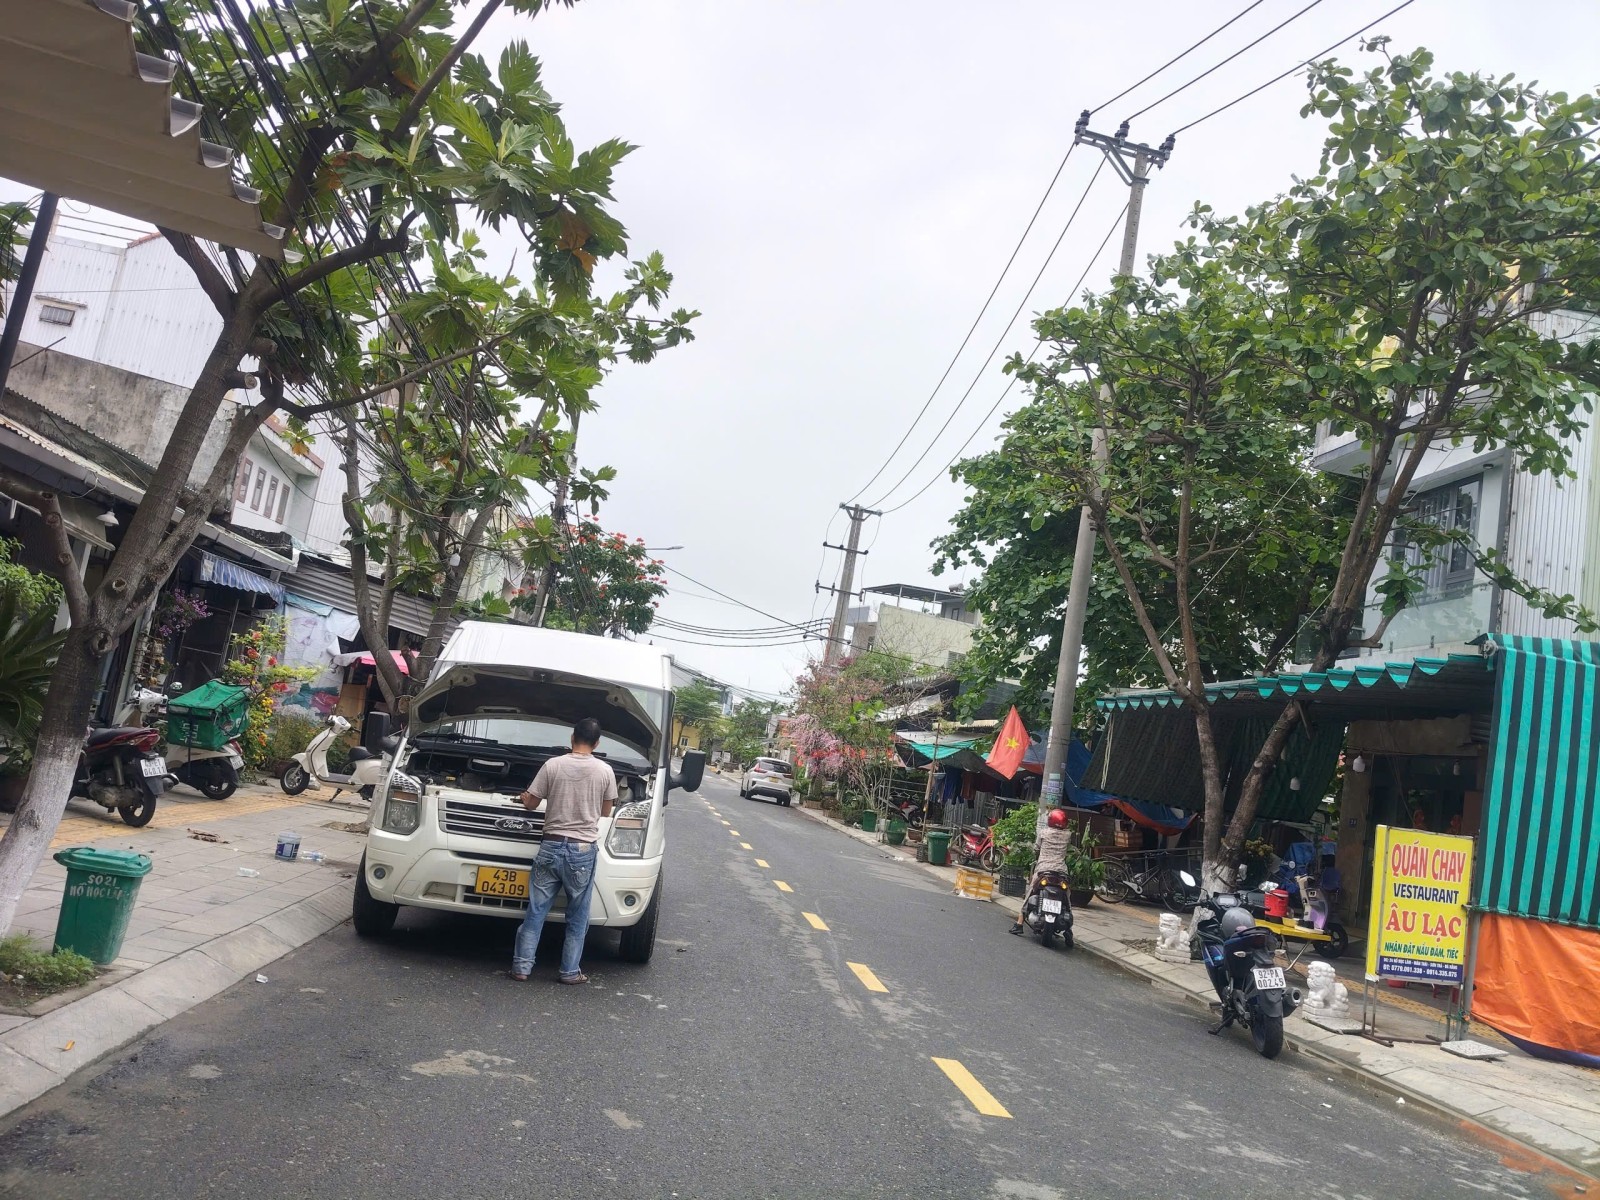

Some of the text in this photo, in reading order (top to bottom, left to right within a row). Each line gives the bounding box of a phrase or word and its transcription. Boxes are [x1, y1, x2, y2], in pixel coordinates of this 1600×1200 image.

[1391, 840, 1466, 883] QUÁN CHAY
[493, 869, 517, 882] 43B
[481, 881, 525, 896] 043.09
[1393, 882, 1459, 905] VESTAURANT
[1385, 902, 1462, 942] ÂU LẠC
